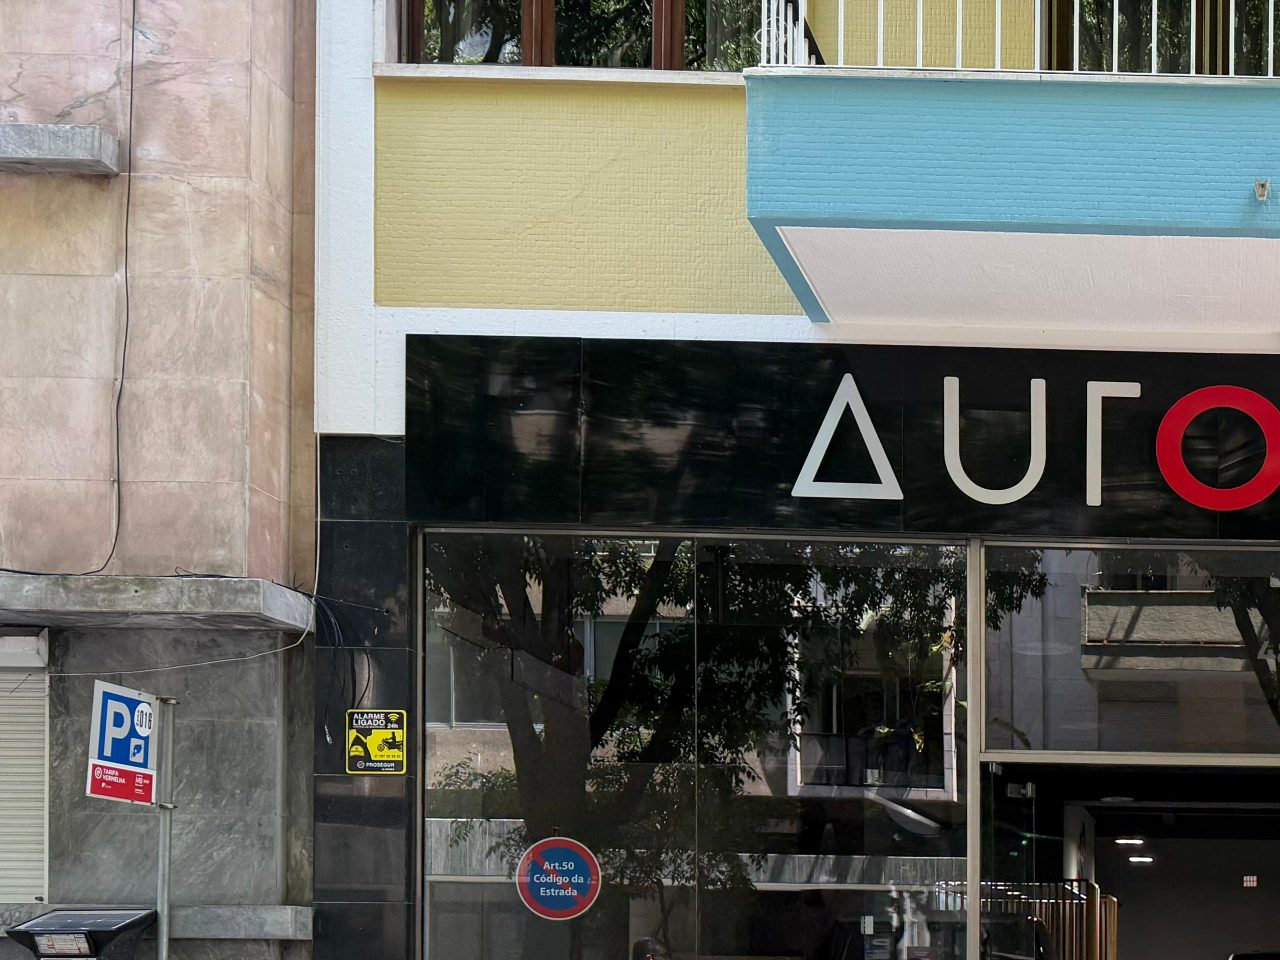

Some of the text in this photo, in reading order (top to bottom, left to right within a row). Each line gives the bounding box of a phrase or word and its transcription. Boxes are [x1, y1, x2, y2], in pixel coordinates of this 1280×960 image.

[104, 699, 131, 757] P
[140, 710, 152, 730] 016
[103, 768, 119, 776] TARIFA
[102, 774, 126, 784] VERMELHA
[543, 862, 574, 870] Art.50
[533, 874, 584, 884] Código da
[540, 887, 578, 896] Estrada
